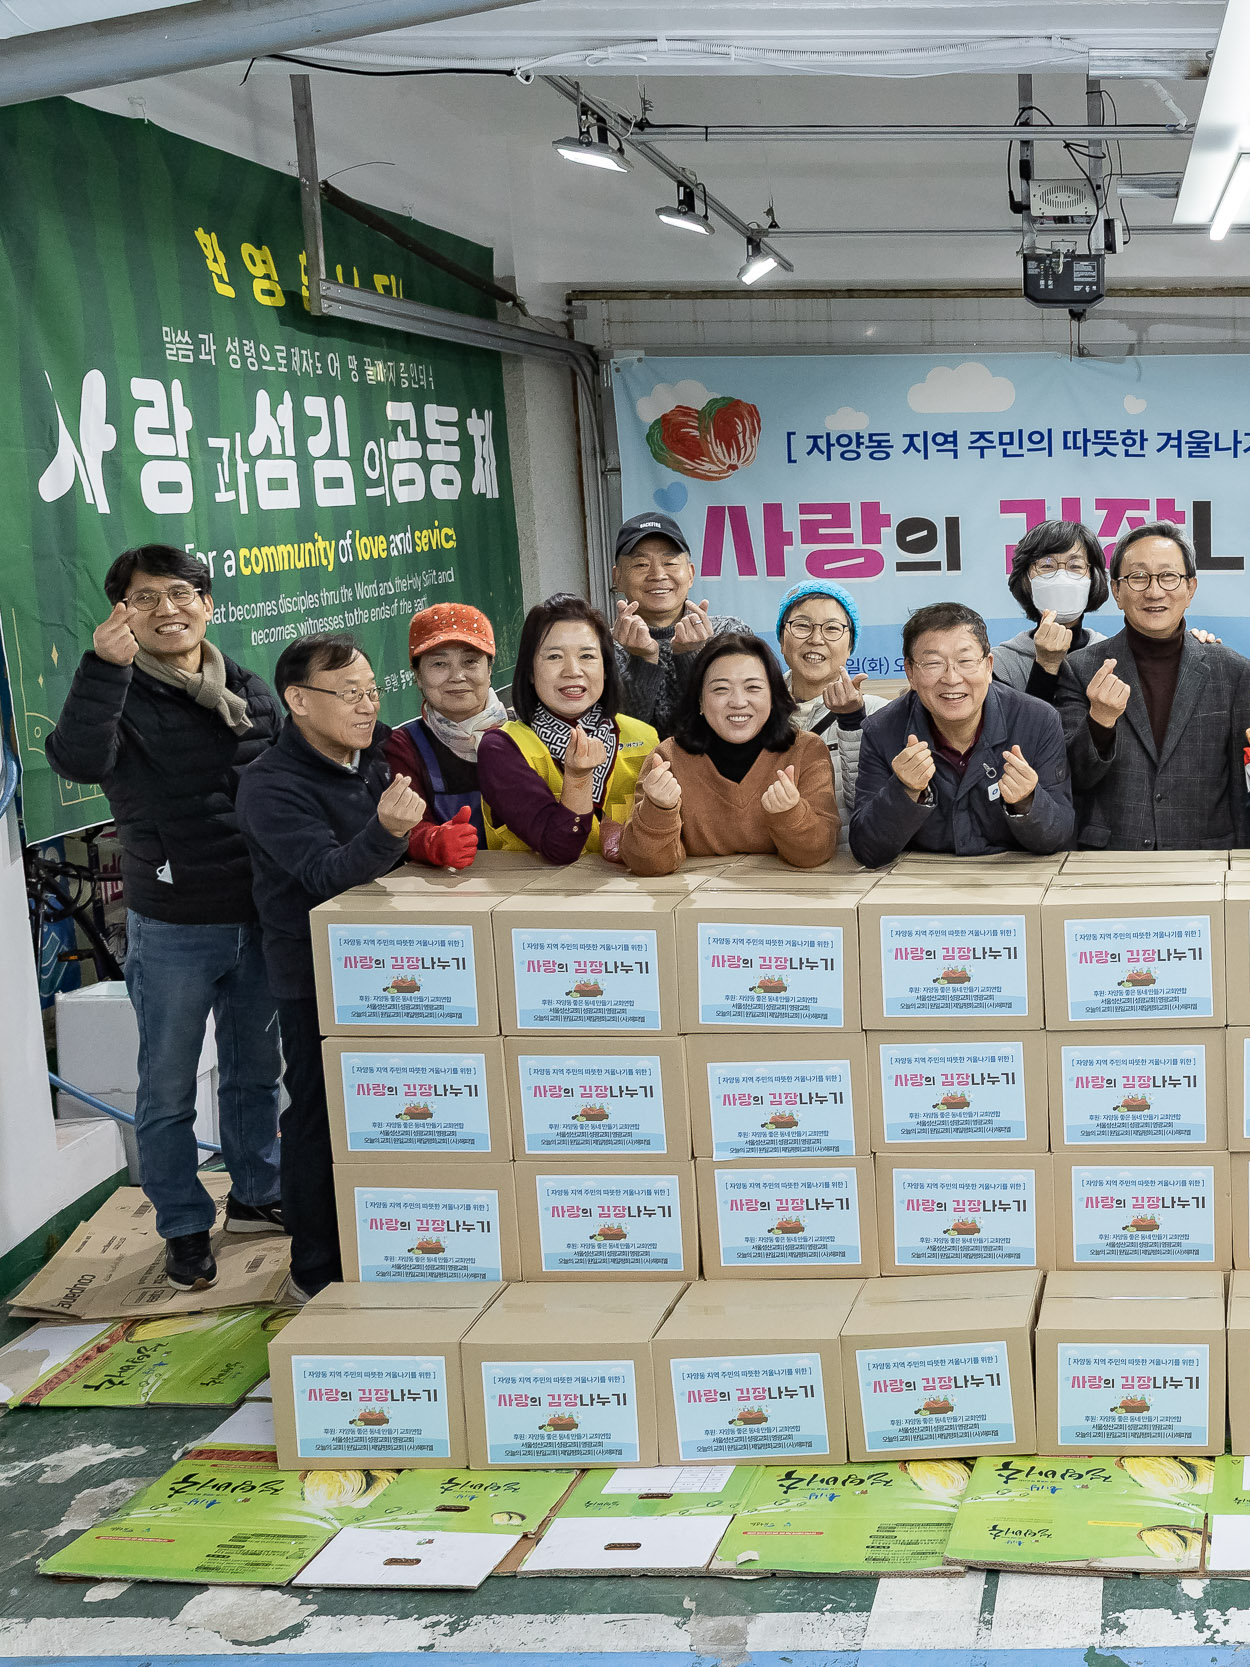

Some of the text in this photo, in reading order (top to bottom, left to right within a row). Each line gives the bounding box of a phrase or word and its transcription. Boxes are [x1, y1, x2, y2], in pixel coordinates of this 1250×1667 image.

[38, 369, 500, 515] 사랑과 섬김의 공동체
[806, 431, 894, 462] 자양동
[902, 430, 959, 461] 지역
[967, 429, 1054, 461] 주민의
[1062, 427, 1149, 459] 따뜻한
[700, 501, 962, 581] 사랑의
[223, 549, 236, 578] a
[238, 531, 336, 576] community
[338, 529, 353, 564] of
[355, 530, 388, 561] love
[228, 600, 278, 622] becomes
[278, 590, 320, 614] disciples
[320, 587, 340, 606] thru
[340, 584, 353, 602] the
[354, 580, 378, 600] Word
[251, 623, 298, 646] becomes
[297, 614, 344, 637] witnesses
[399, 597, 412, 615] the
[894, 946, 1018, 961] 사랑의 김장나누기
[1079, 947, 1203, 965] 사랑의 김장나누기
[343, 955, 466, 971] 사랑의 김장나누기
[711, 954, 835, 972] 사랑의 김장나누기
[894, 1071, 1016, 1088] 사랑의 김장나누기
[1075, 1074, 1197, 1090] 사랑의 김장나누기
[356, 1082, 479, 1098] 사랑의 김장나누기
[533, 1084, 654, 1099] 사랑의 김장나누기
[729, 1197, 850, 1213] 사랑의 김장나누기
[1084, 1195, 1206, 1210] 사랑의 김장나누기
[551, 1205, 672, 1219] 사랑의 김장나누기
[1071, 1375, 1200, 1391] 사랑의 김장나누기
[307, 1387, 438, 1403] 사랑의 김장나누기
[497, 1392, 627, 1409] 사랑의 김장나누기
[687, 1384, 815, 1404] 사랑의 김장나누기
[775, 1466, 893, 1495] 절임배추
[994, 1460, 1112, 1484] 절임배추
